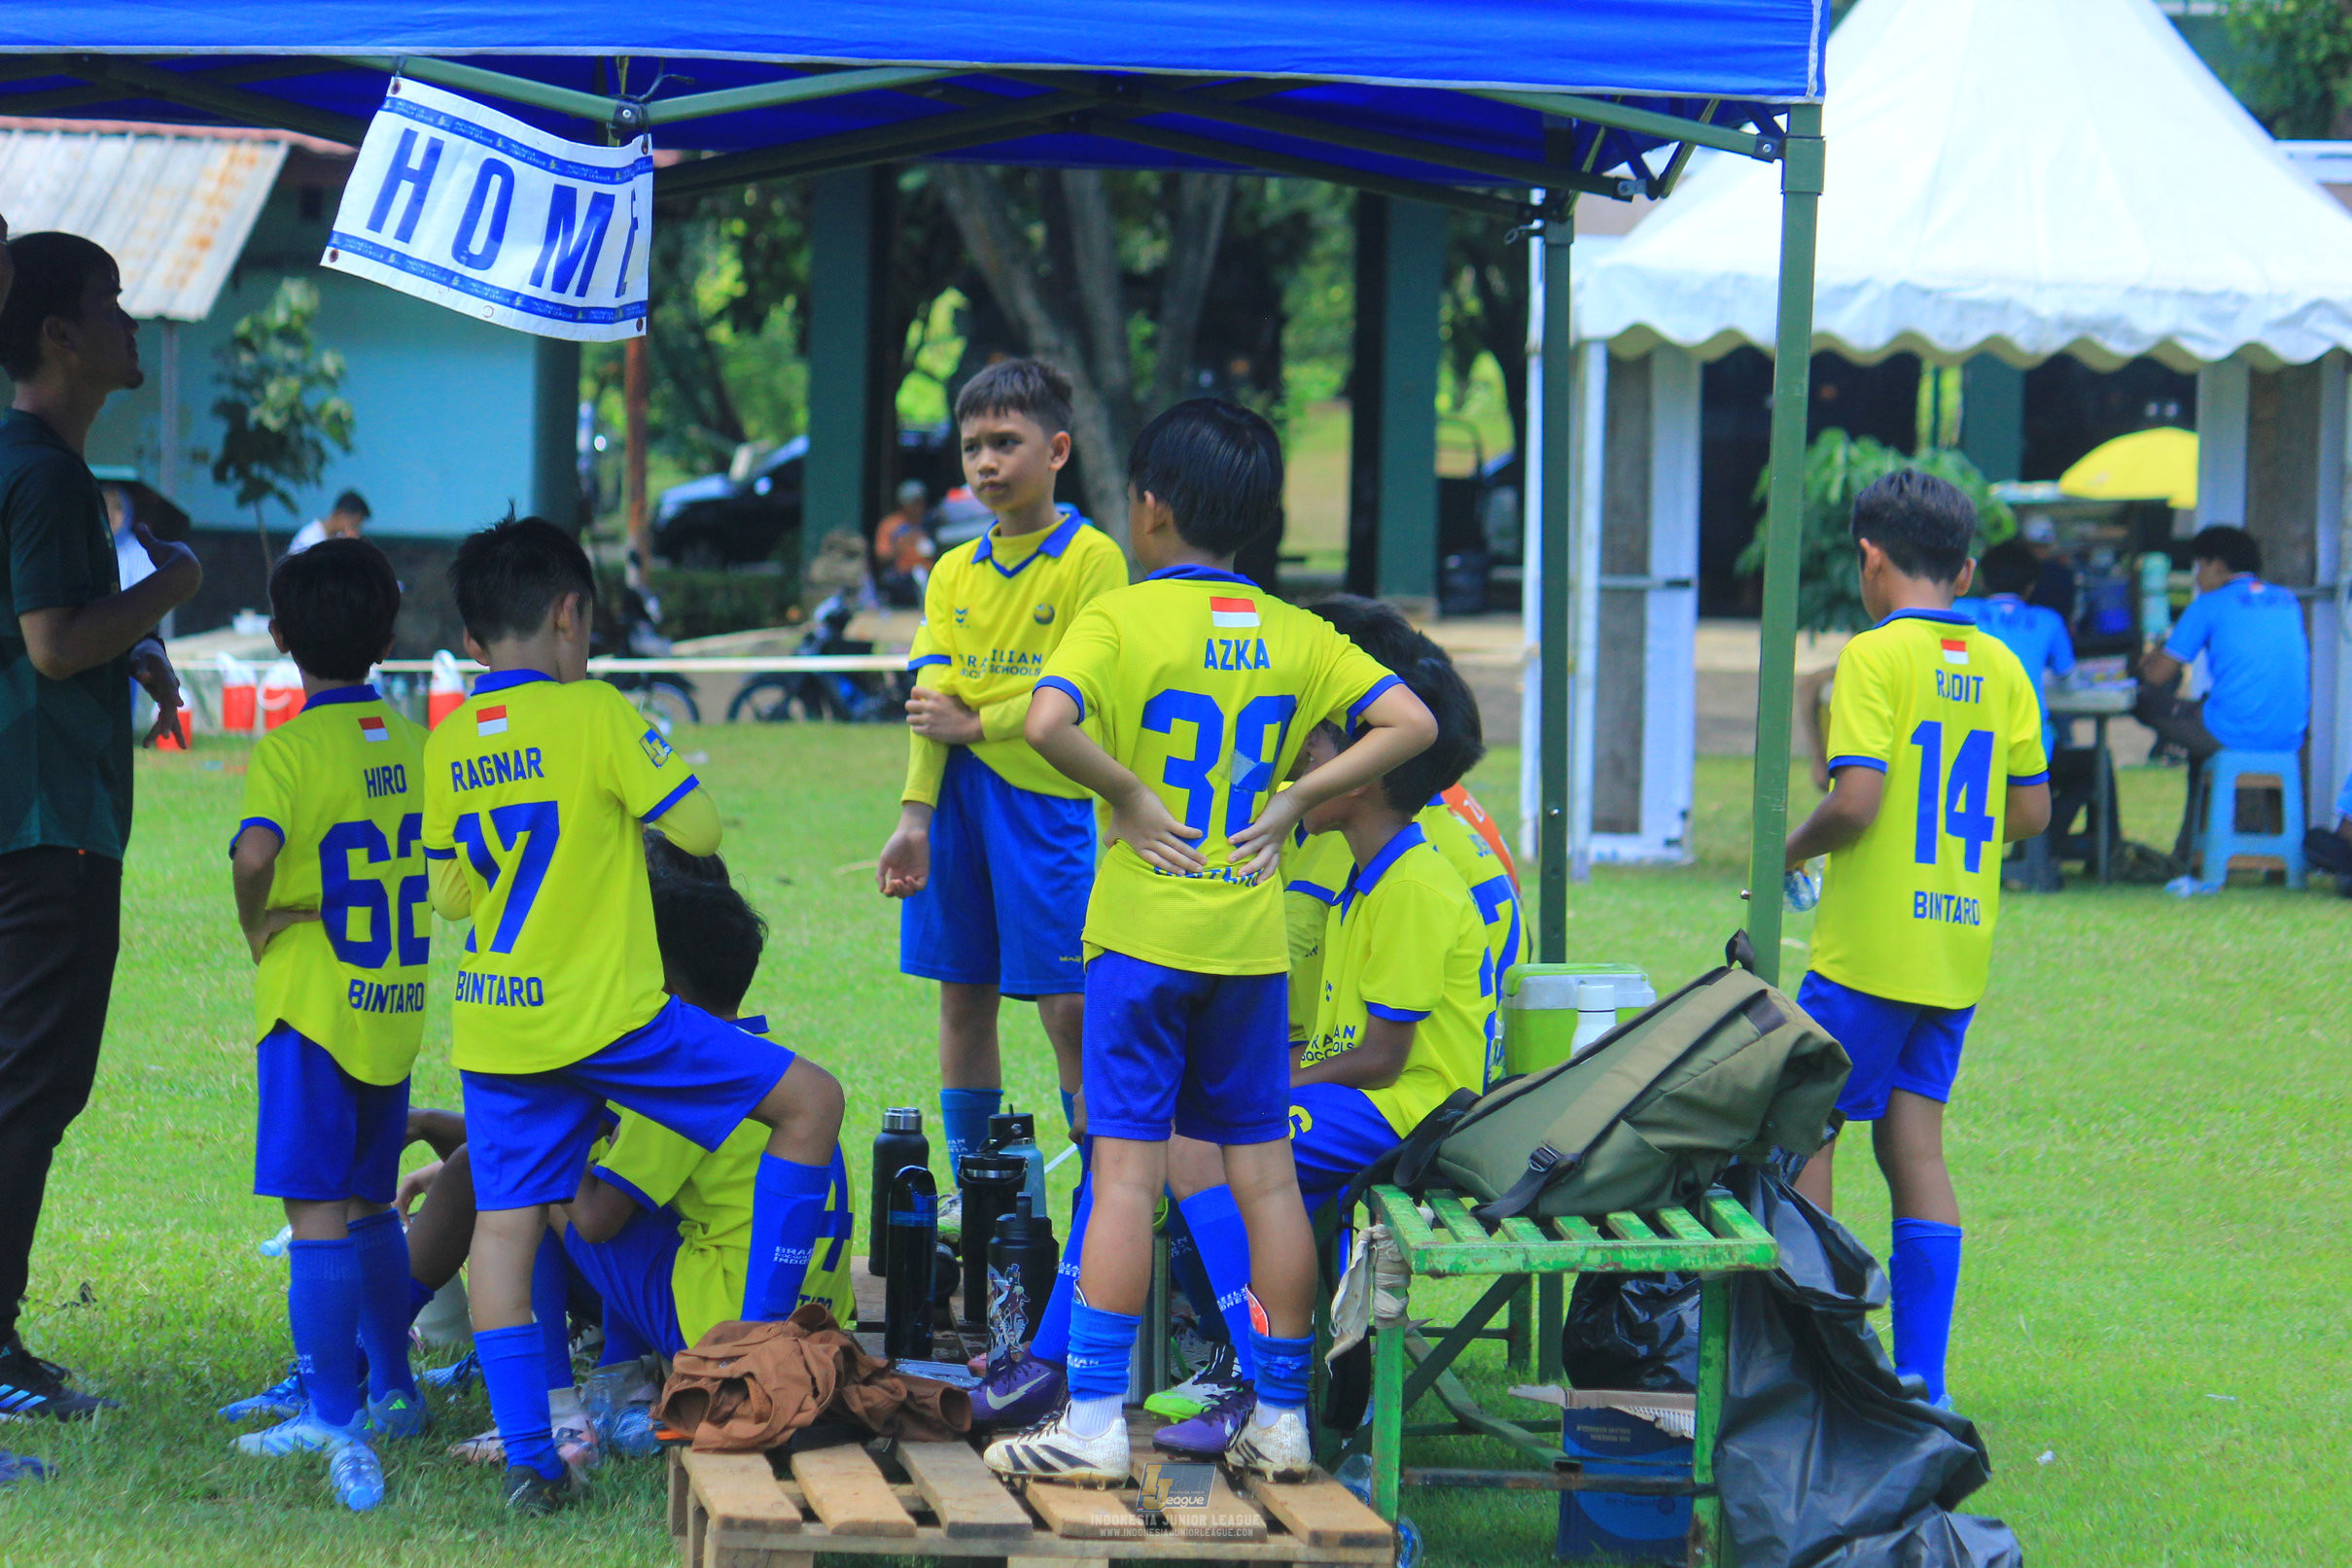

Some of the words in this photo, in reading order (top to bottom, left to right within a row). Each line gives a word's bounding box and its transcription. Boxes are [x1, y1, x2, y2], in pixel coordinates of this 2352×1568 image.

[366, 127, 639, 298] HOM
[1204, 638, 1270, 671] AZKA
[363, 763, 407, 798] HIRO
[450, 747, 544, 792] RAGNAR
[1911, 719, 1995, 874] 14
[452, 800, 560, 954] 17
[1913, 890, 1981, 926] BINTARO
[348, 978, 425, 1014] BINTARO
[455, 970, 544, 1007] BINTARO
